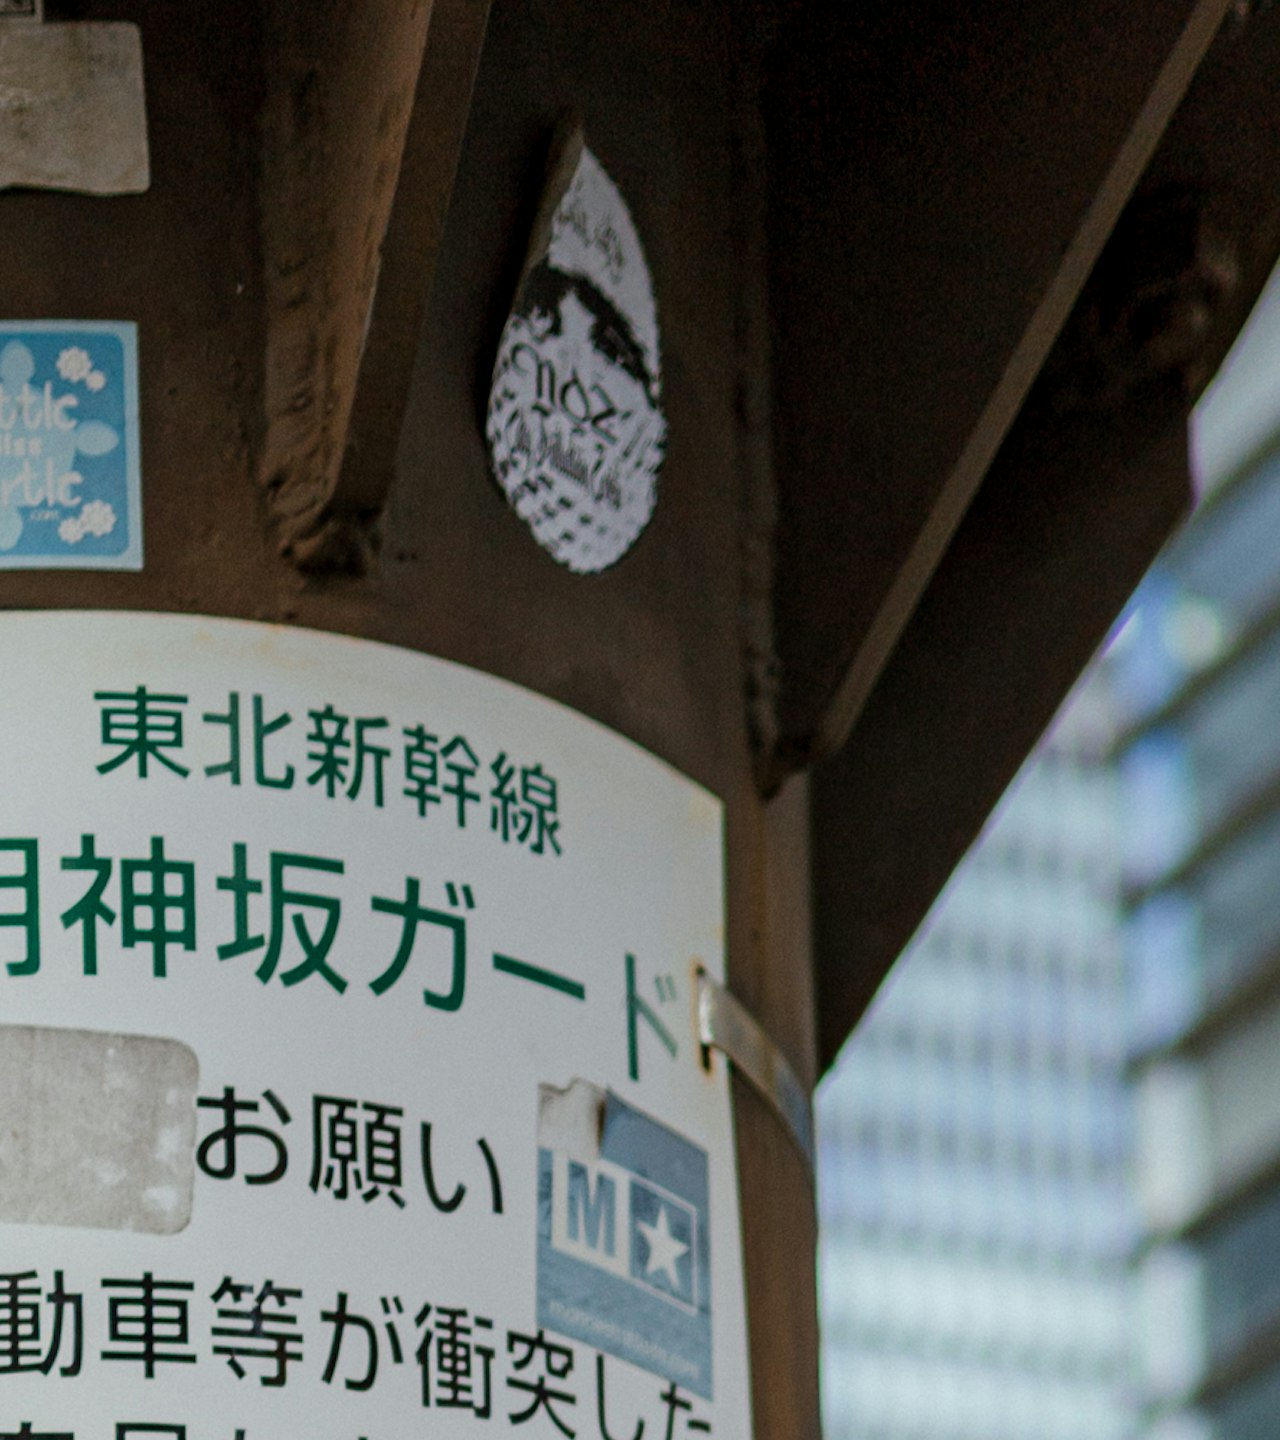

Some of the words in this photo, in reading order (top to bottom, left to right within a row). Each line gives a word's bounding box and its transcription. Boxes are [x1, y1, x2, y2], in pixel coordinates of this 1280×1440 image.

[92, 685, 564, 859] 東北新幹線
[194, 1084, 507, 1217] お願い
